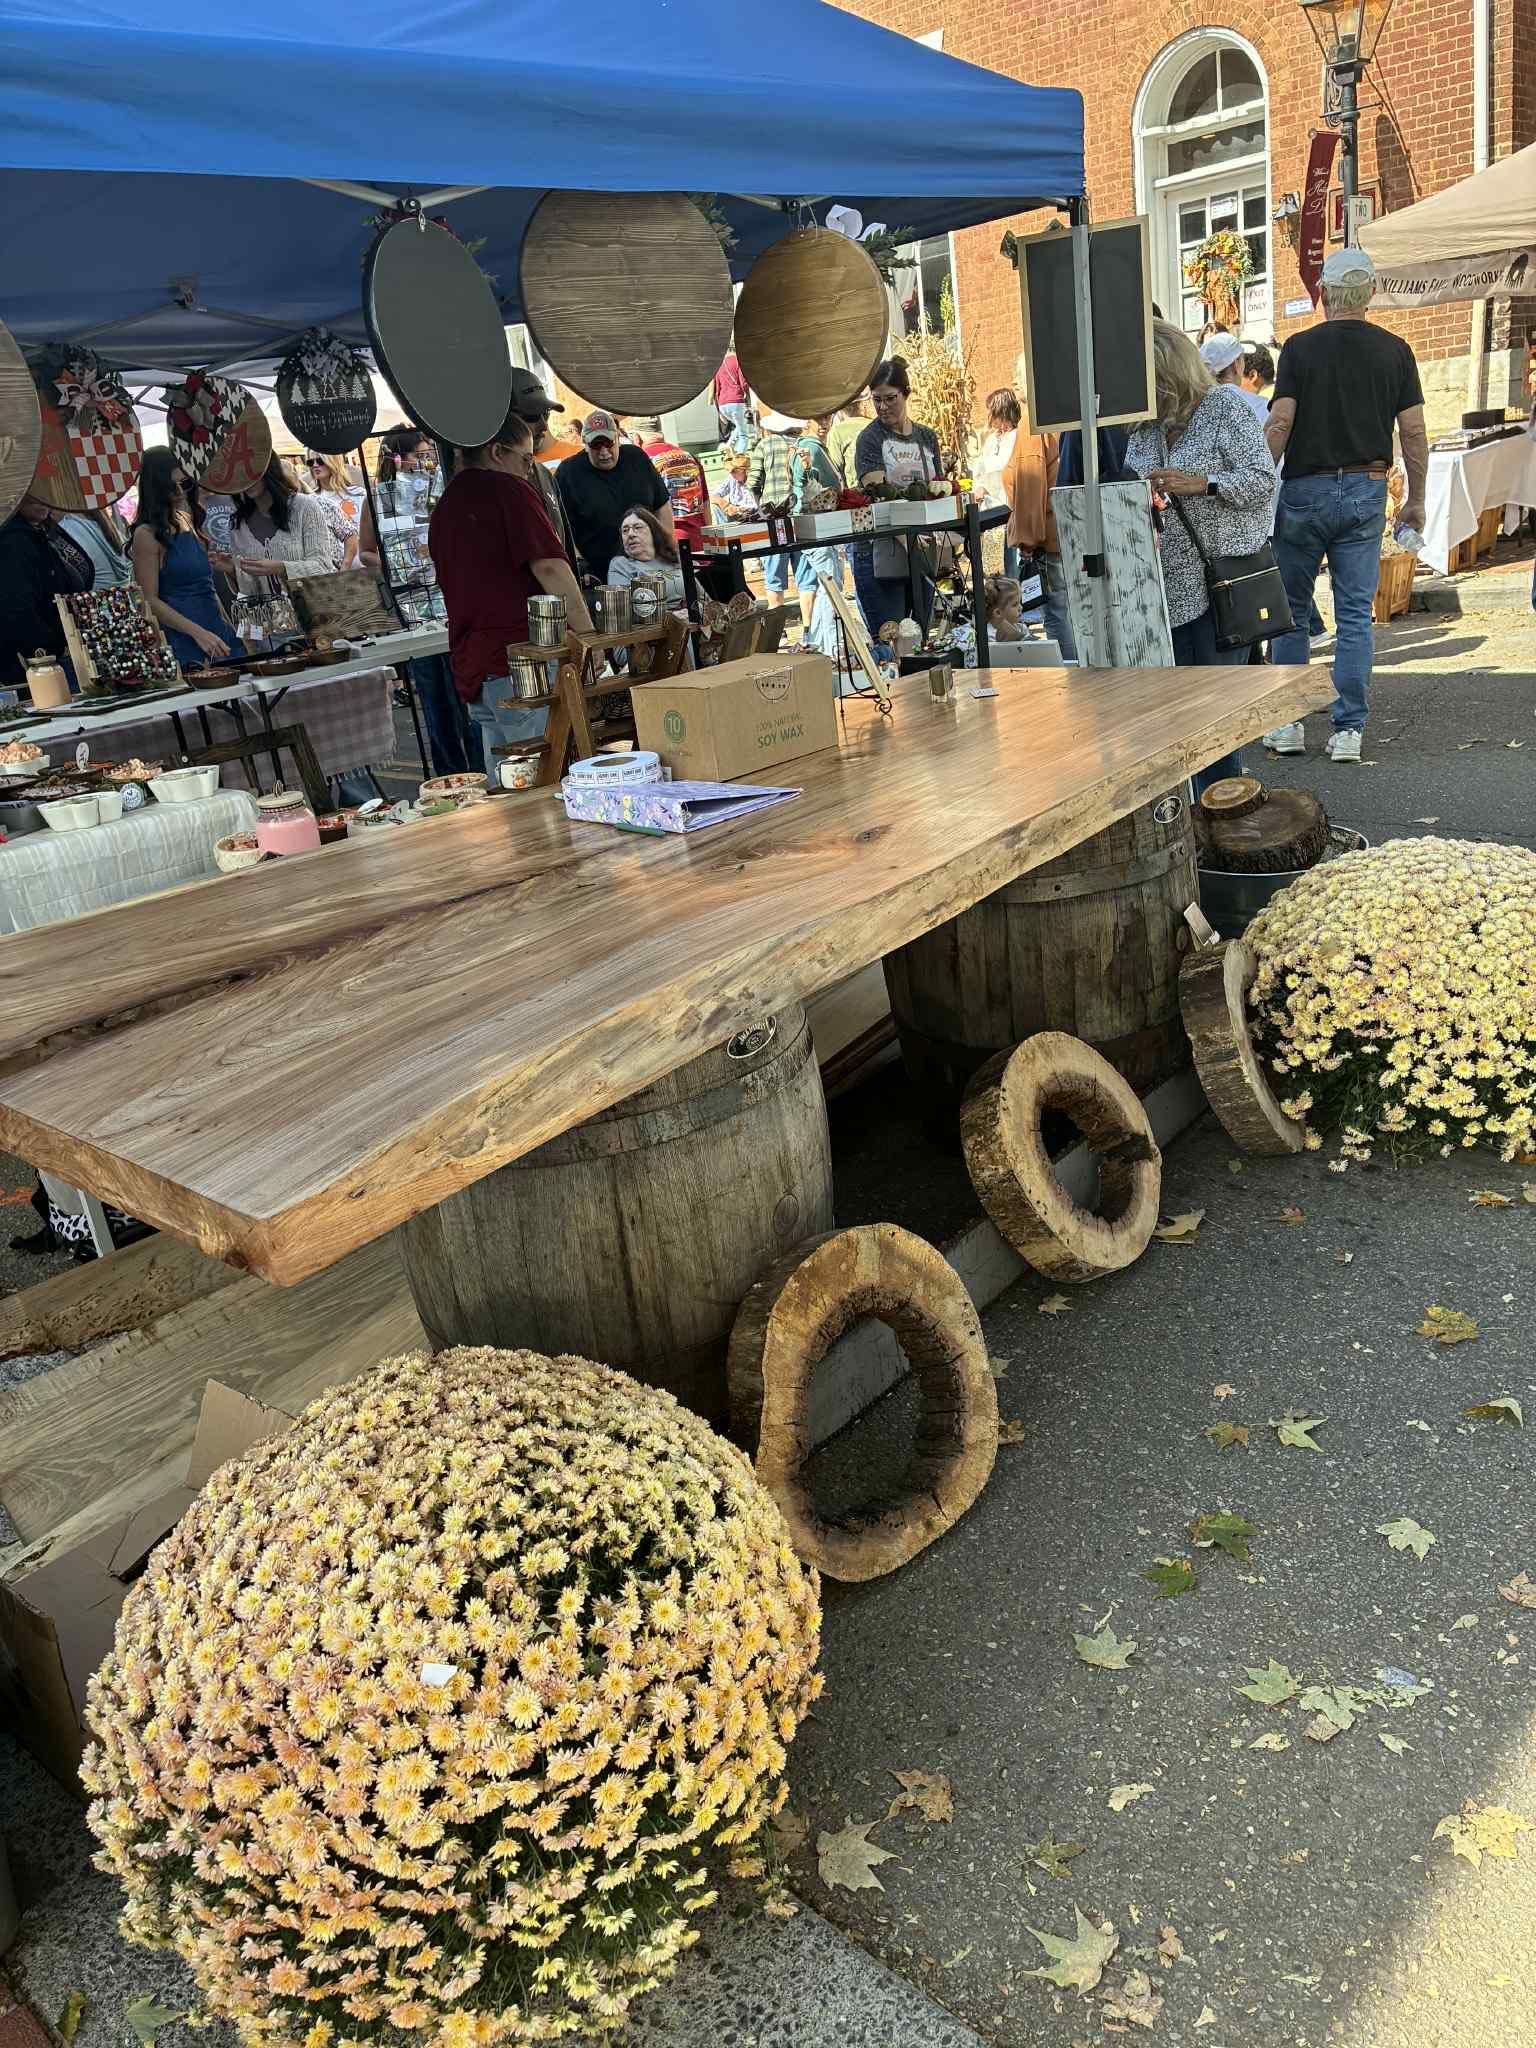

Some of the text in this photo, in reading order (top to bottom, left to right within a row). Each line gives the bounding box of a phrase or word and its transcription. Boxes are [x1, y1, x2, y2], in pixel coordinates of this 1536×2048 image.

[1381, 276, 1428, 294] WILLIAMS
[757, 724, 804, 749] SOY WAX
